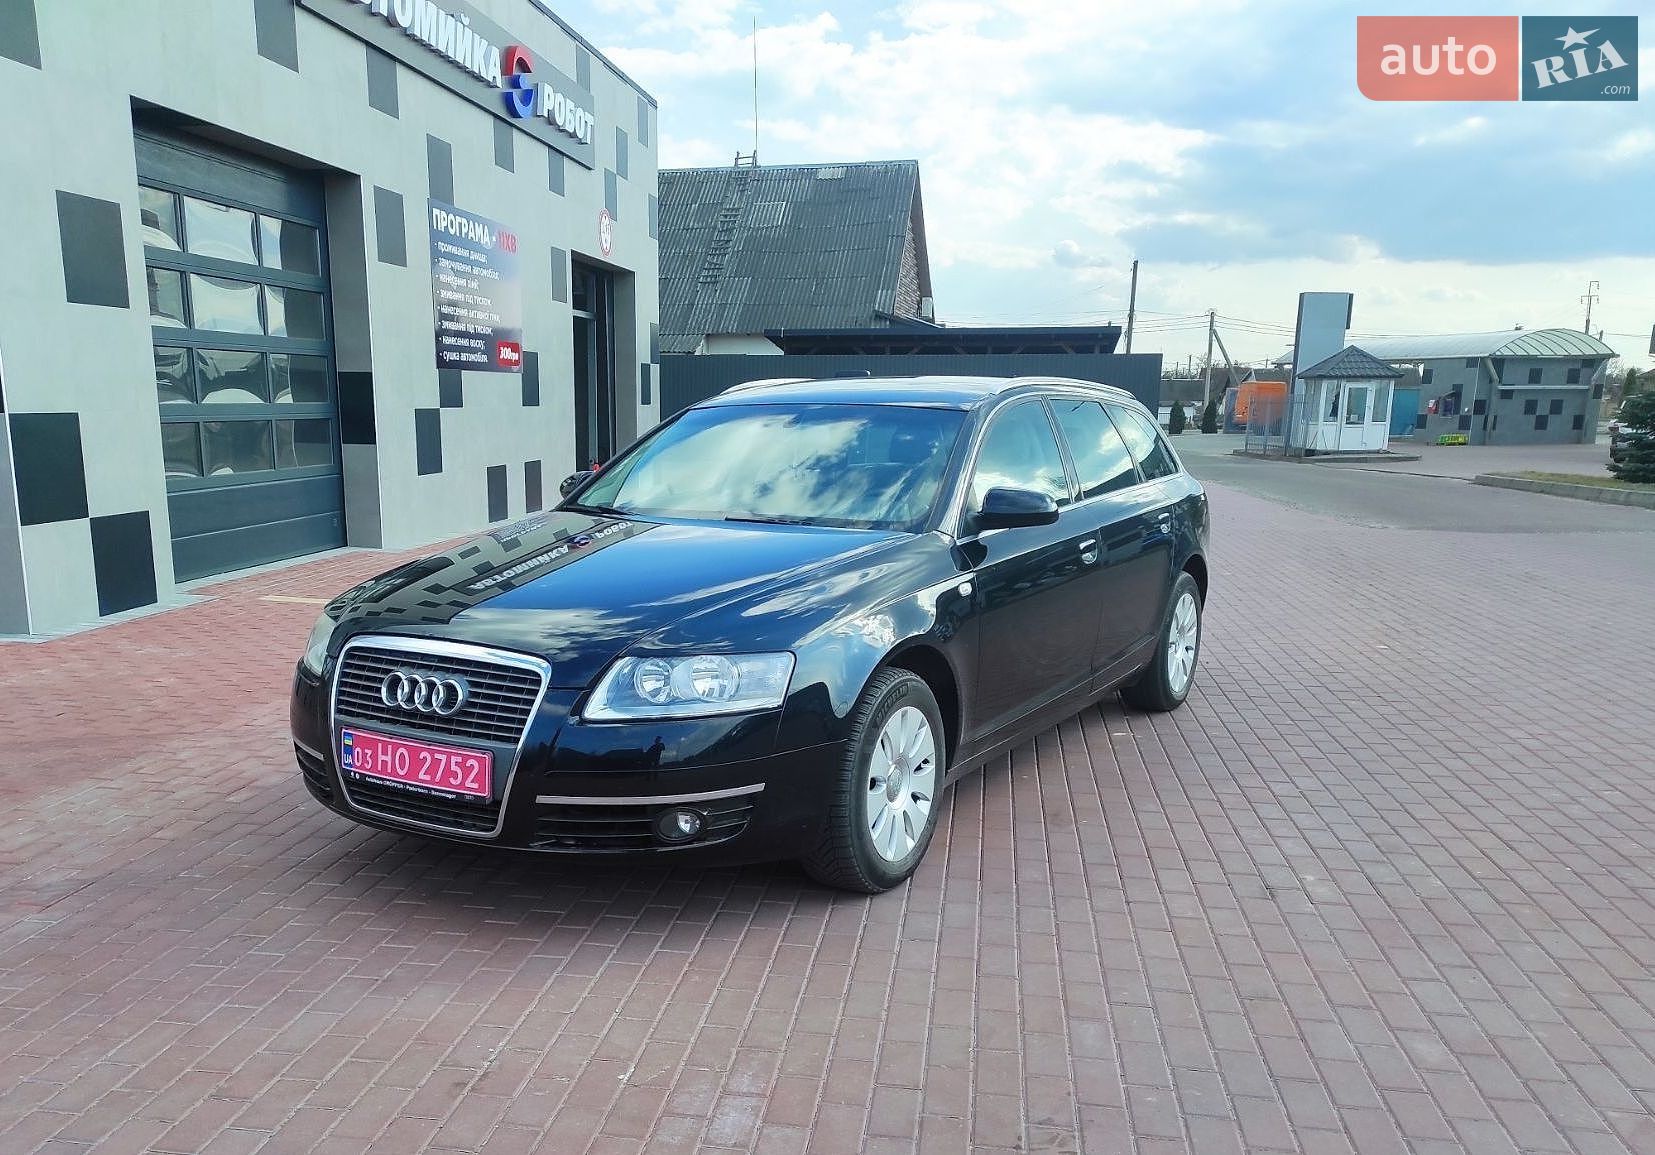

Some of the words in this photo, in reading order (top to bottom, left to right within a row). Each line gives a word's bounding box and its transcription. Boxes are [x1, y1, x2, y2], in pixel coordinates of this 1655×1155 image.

[355, 0, 502, 88] ОМИЙКА
[537, 82, 594, 145] РОБОТ
[432, 207, 489, 245] ПРОГРАМА
[442, 336, 468, 346] нанесення
[443, 351, 459, 361] сушка
[344, 753, 353, 765] UA
[418, 751, 480, 789] 2752
